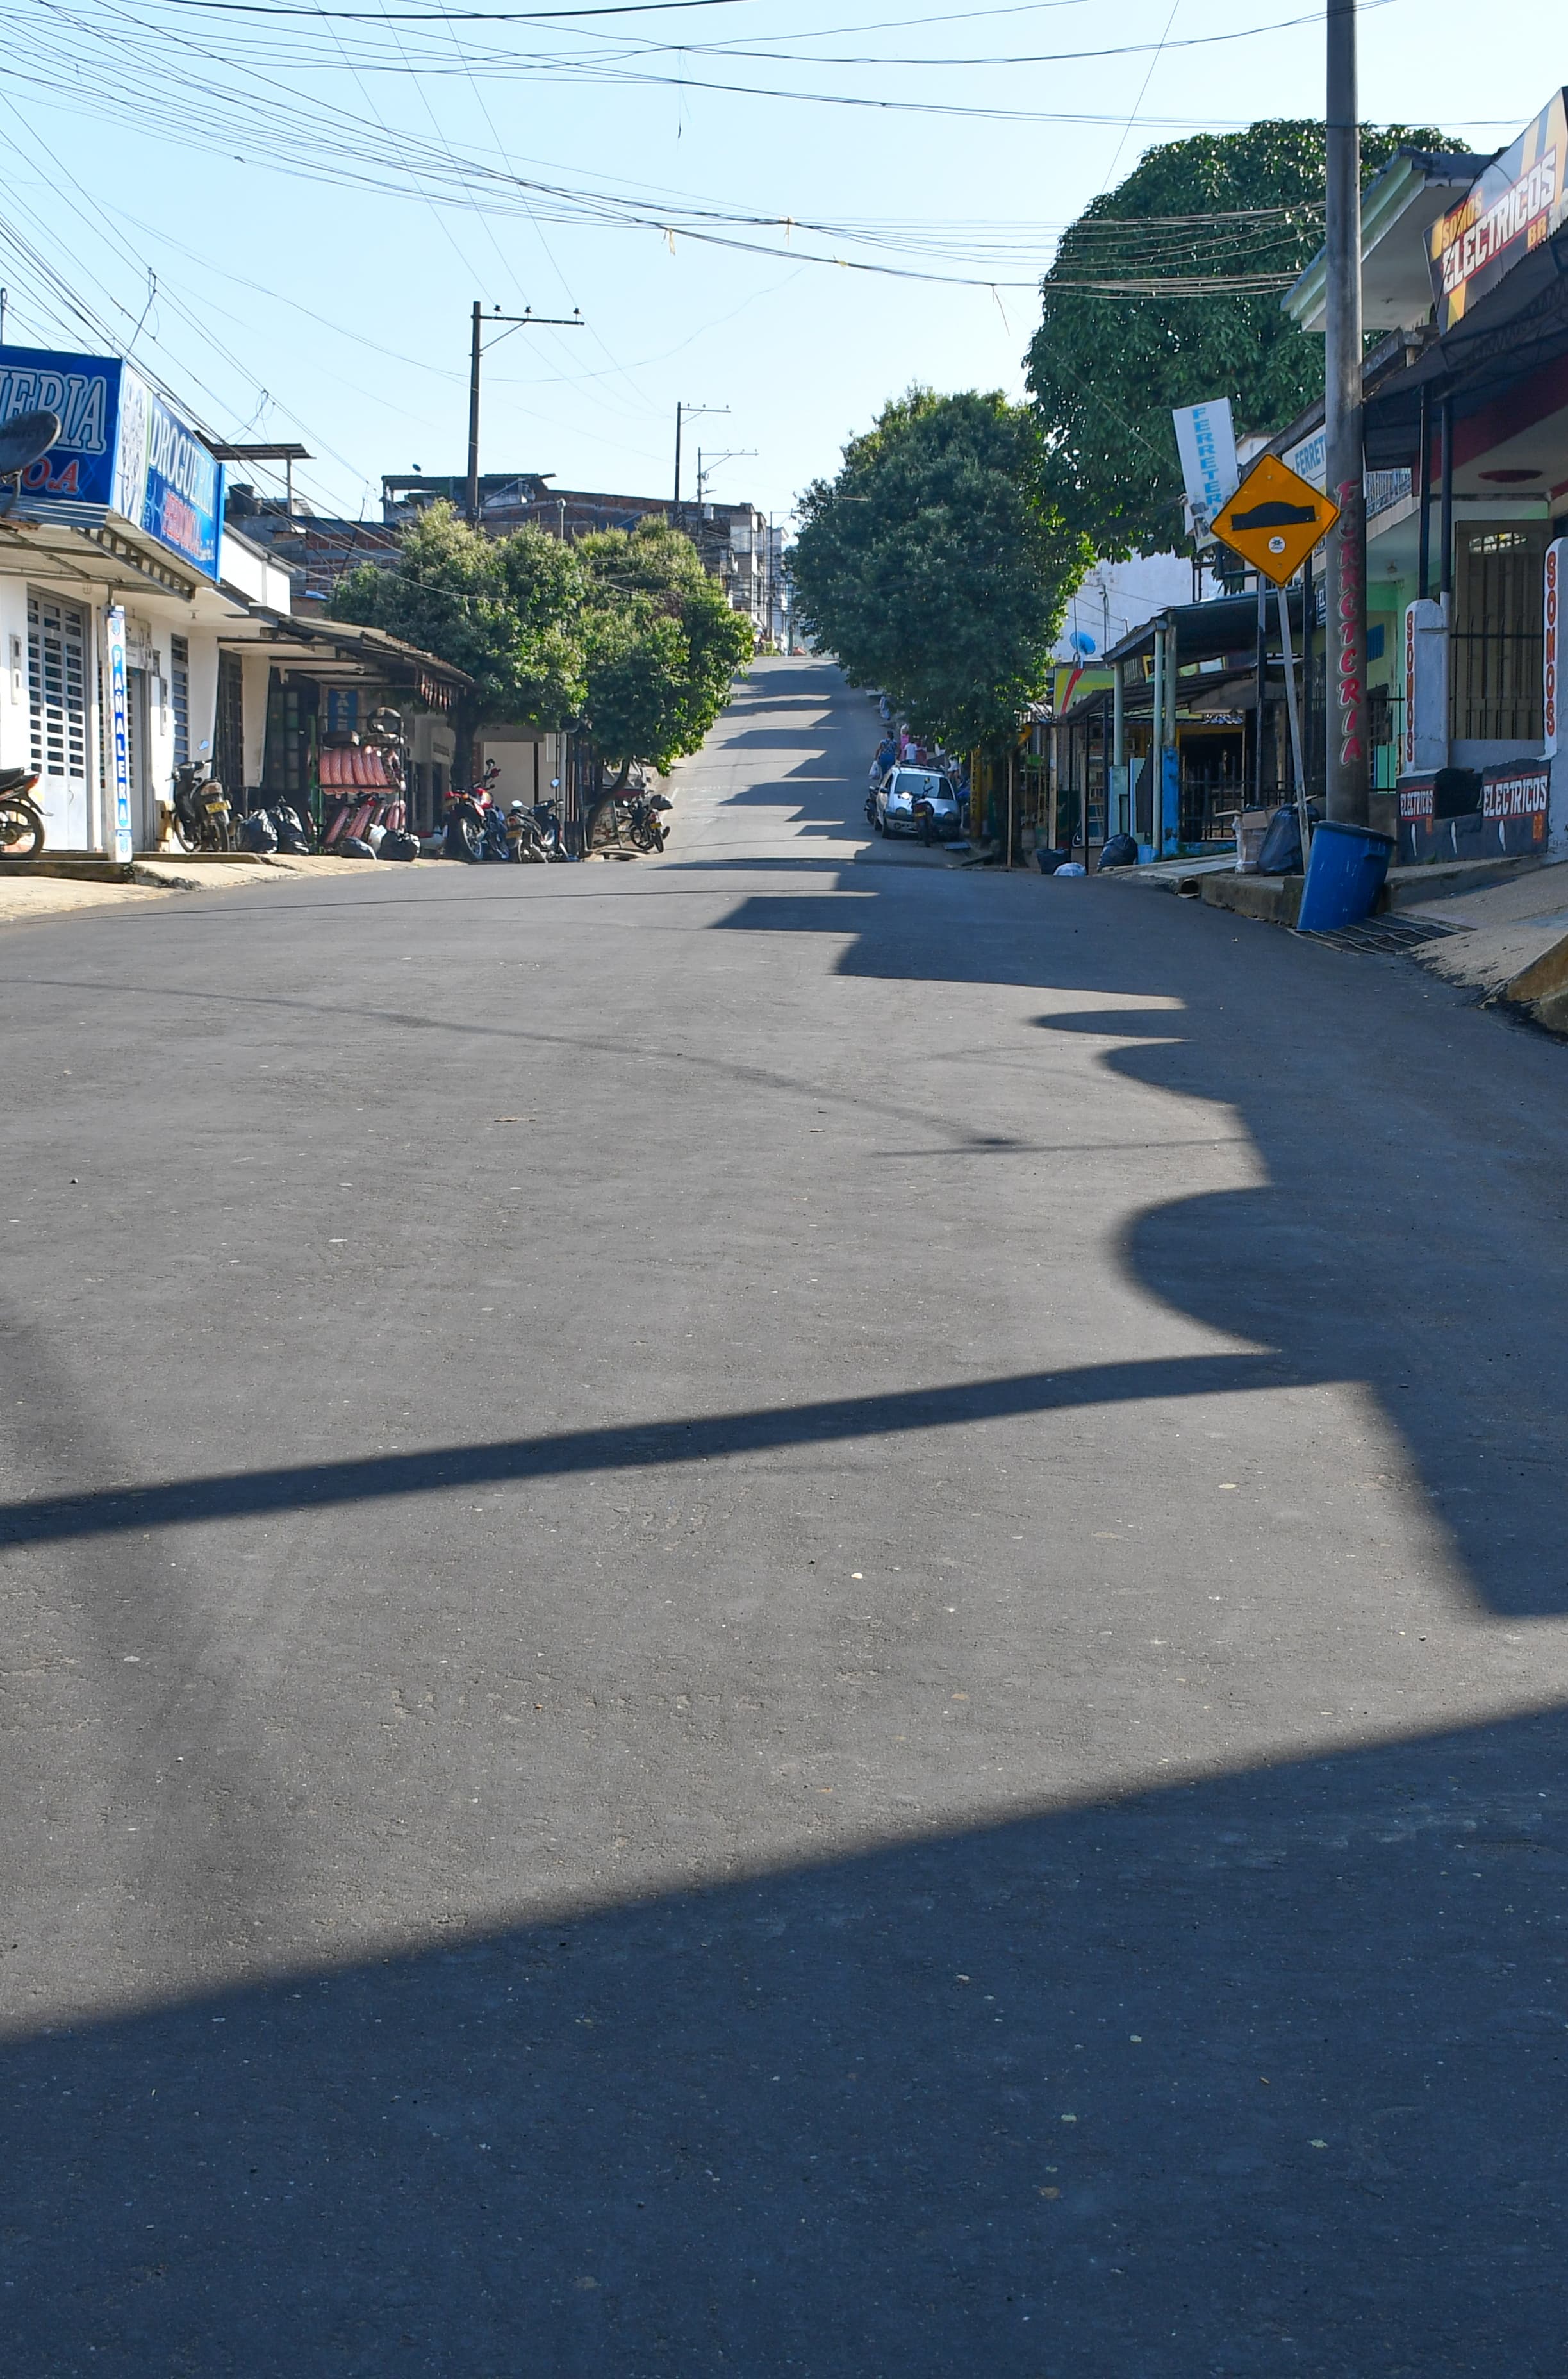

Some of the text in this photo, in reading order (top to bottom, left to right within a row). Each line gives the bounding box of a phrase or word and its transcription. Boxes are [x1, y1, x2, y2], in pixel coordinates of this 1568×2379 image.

[1442, 188, 1482, 249] SOMOS
[1442, 151, 1556, 295] ELECTRICOS
[1527, 215, 1547, 249] BR
[0, 369, 103, 450] ERIA
[1333, 479, 1363, 765] FERRETERIA
[1546, 551, 1557, 737] SOMOS
[1399, 790, 1433, 817] ELECTRICOS
[1483, 775, 1548, 817] ELECTRICOS
